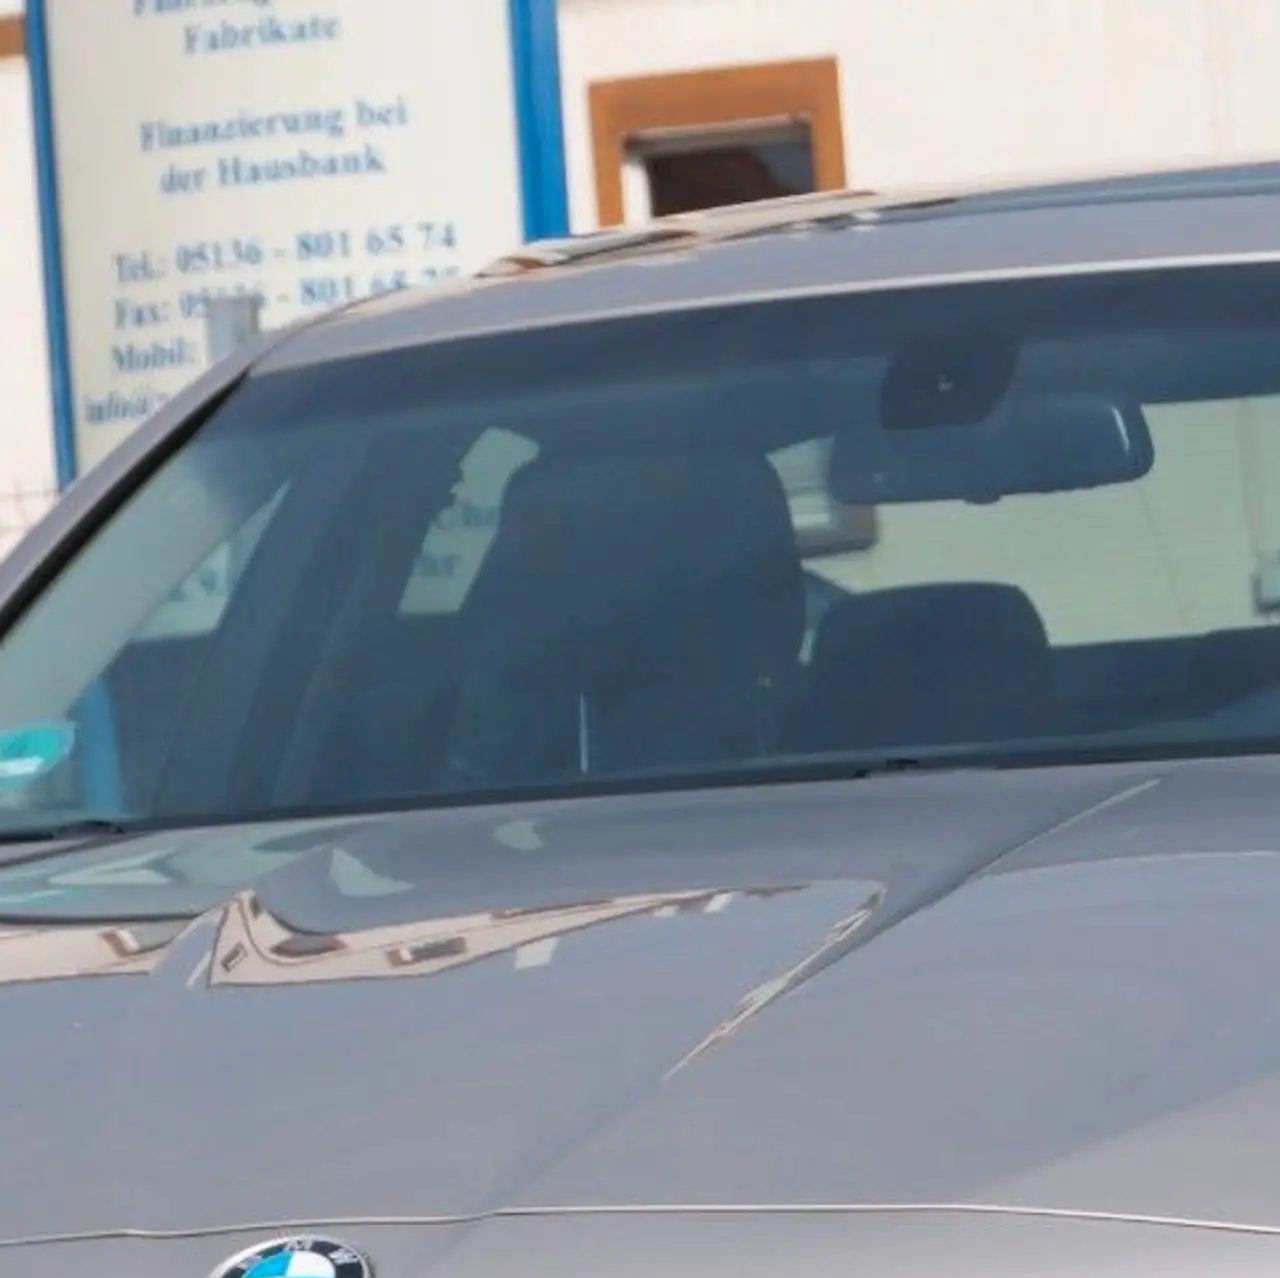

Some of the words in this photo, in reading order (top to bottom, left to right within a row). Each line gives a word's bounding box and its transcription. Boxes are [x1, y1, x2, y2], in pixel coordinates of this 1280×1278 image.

[183, 15, 338, 54] Fabrikate
[140, 107, 345, 151] Finanzierung
[356, 93, 407, 126] bei
[160, 163, 206, 194] der
[218, 143, 387, 188] Hausbank
[296, 229, 352, 262] 801
